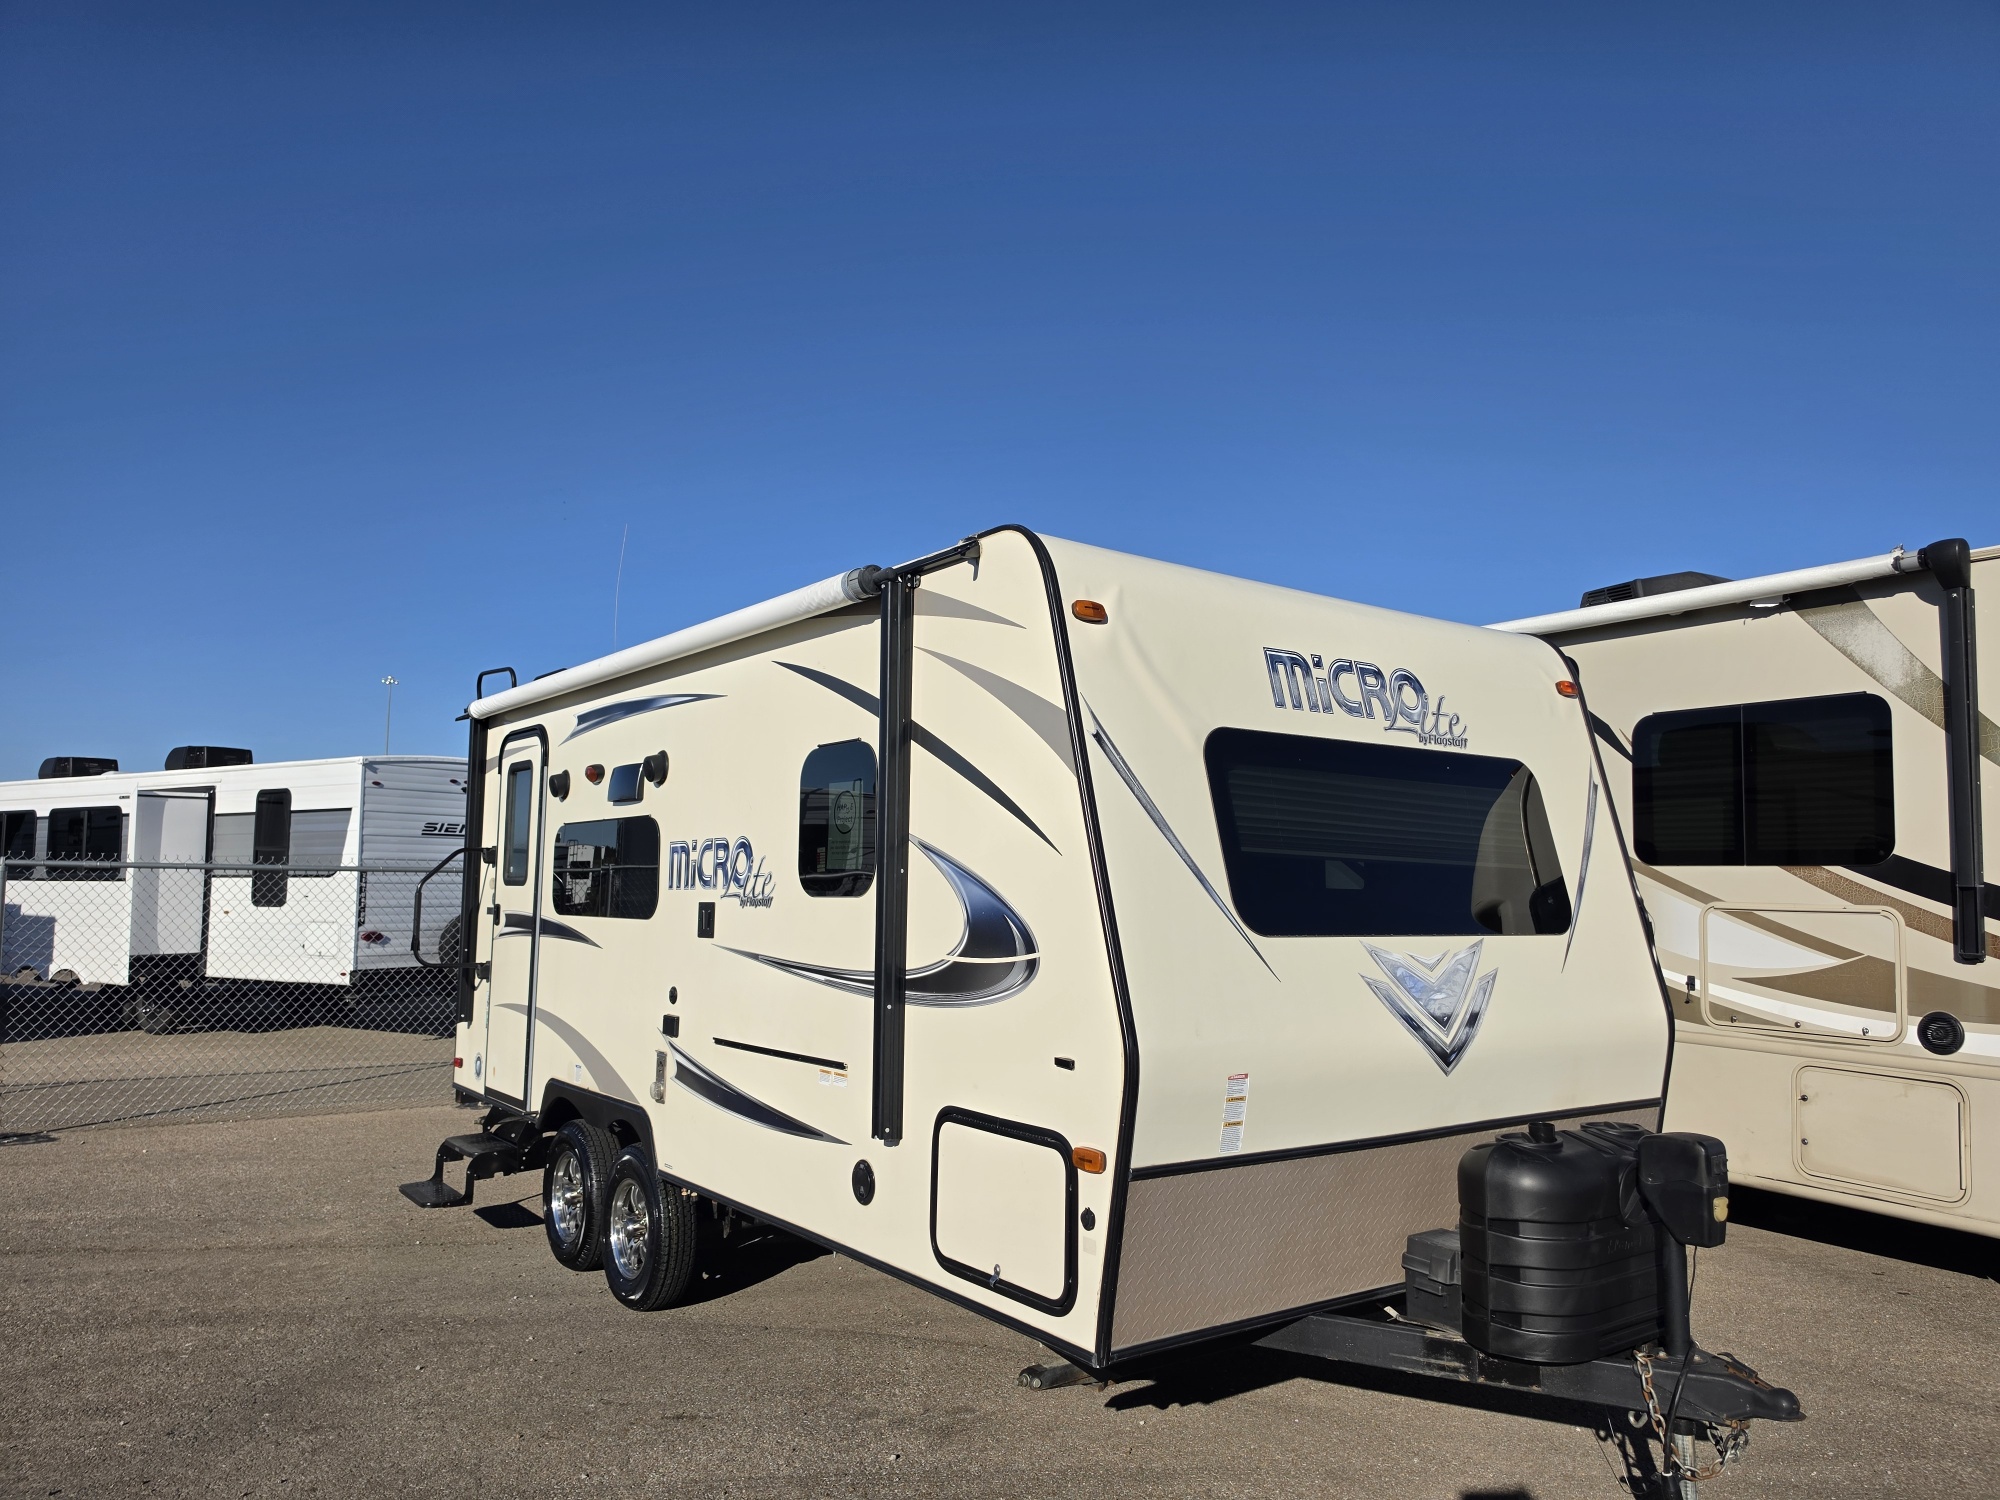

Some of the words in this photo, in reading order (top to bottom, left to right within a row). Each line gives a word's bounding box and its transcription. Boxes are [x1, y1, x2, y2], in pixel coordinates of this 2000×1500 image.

[1384, 680, 1467, 738] Lite
[1418, 733, 1428, 746] by
[1428, 734, 1468, 749] Flagstaff
[720, 848, 776, 899] Lite
[745, 896, 774, 909] Flagstaff
